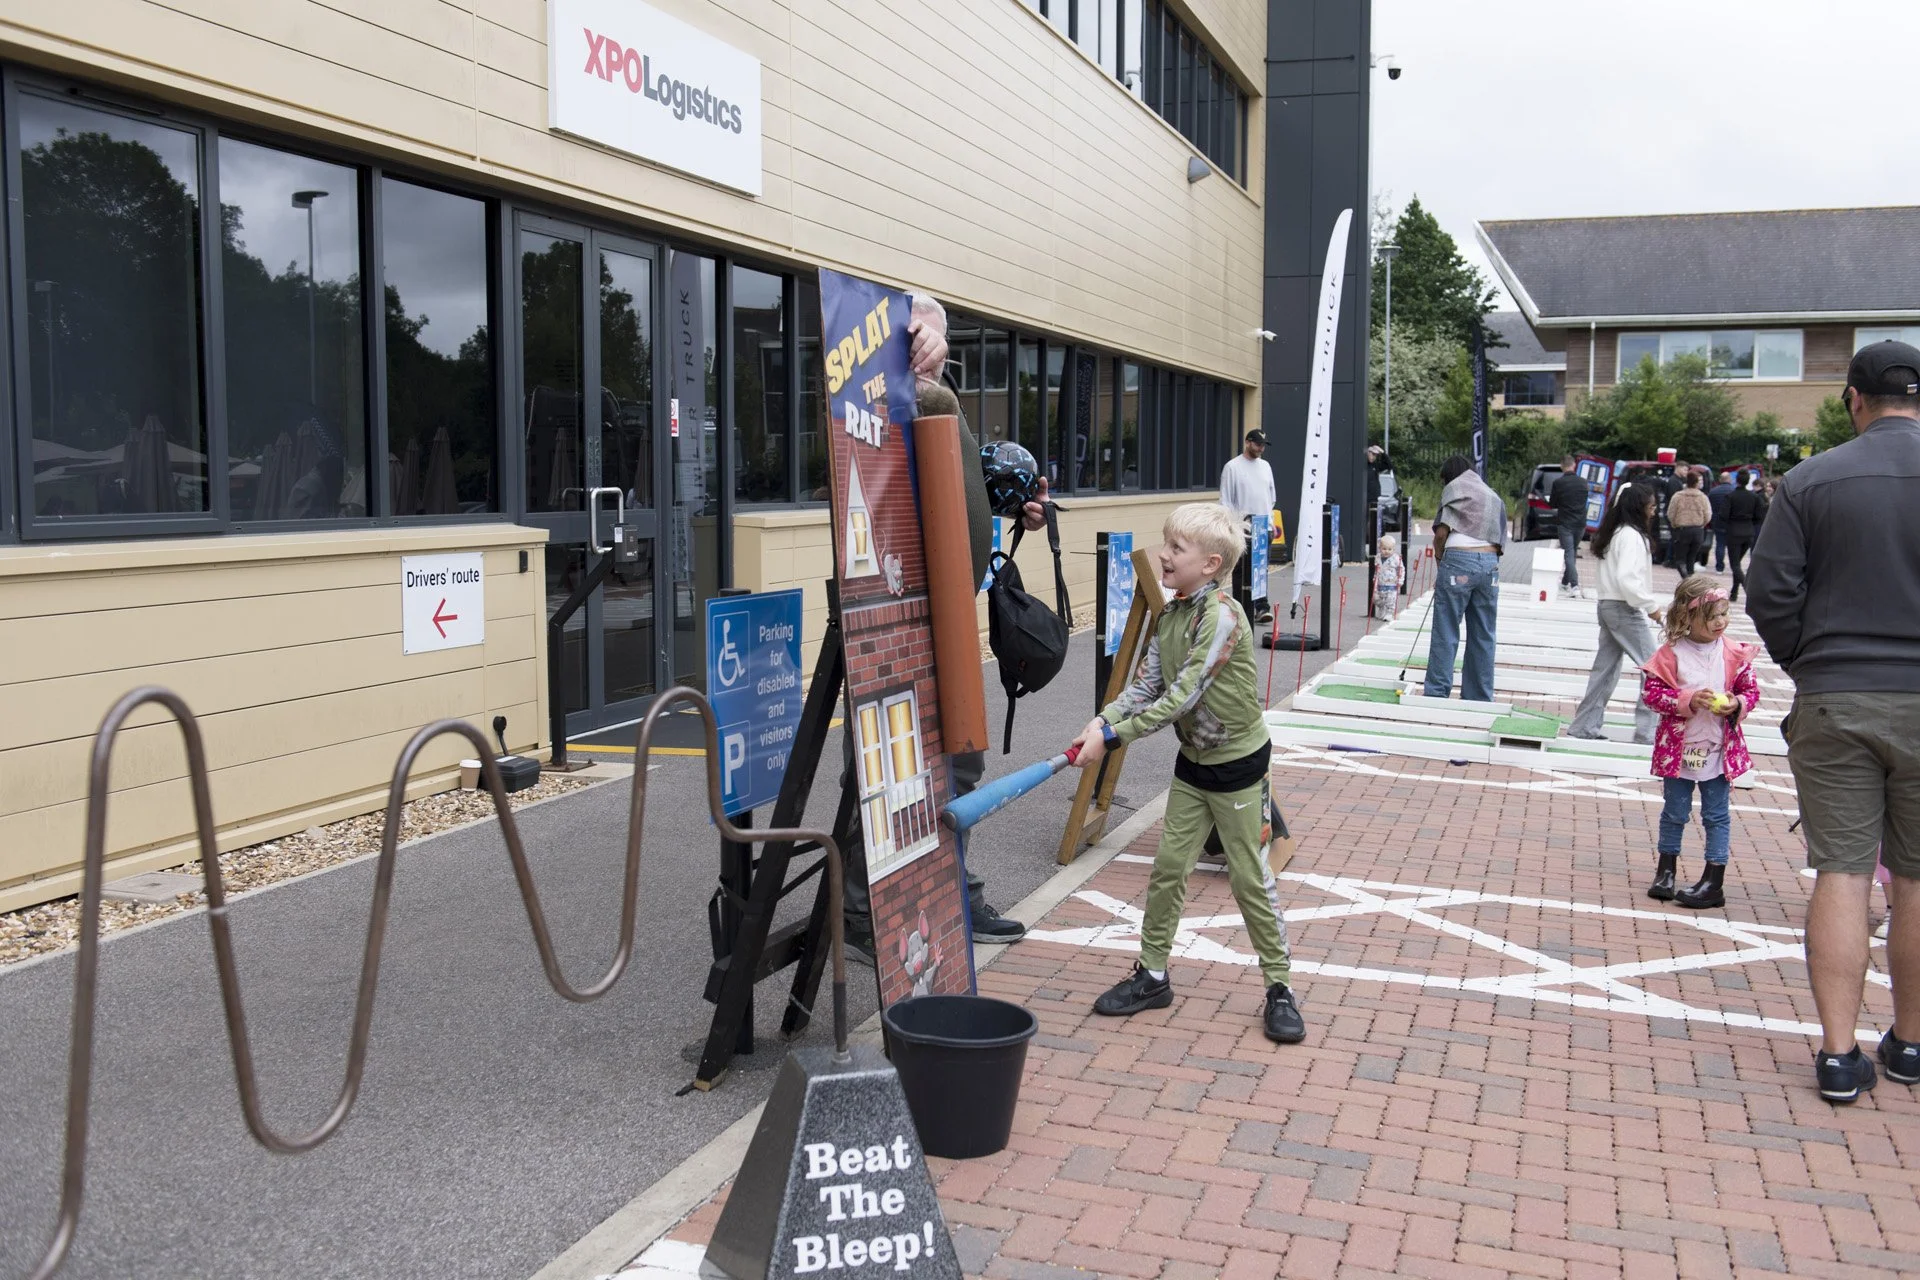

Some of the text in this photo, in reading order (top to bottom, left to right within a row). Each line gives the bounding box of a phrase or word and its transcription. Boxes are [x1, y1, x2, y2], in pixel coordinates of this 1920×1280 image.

[680, 287, 695, 385] TRUCK
[825, 296, 891, 394] SPLAT
[862, 372, 887, 404] THE
[845, 401, 883, 448] RAT
[407, 567, 480, 588] Drivers' route
[759, 624, 794, 643] Parking
[770, 651, 783, 666] for
[757, 674, 795, 695] disabled
[768, 699, 785, 718] and
[760, 725, 793, 747] visitors
[724, 732, 745, 796] P
[767, 751, 786, 770] only
[804, 1135, 911, 1180] Beat
[819, 1183, 905, 1222] The
[792, 1220, 935, 1274] Bleep!
